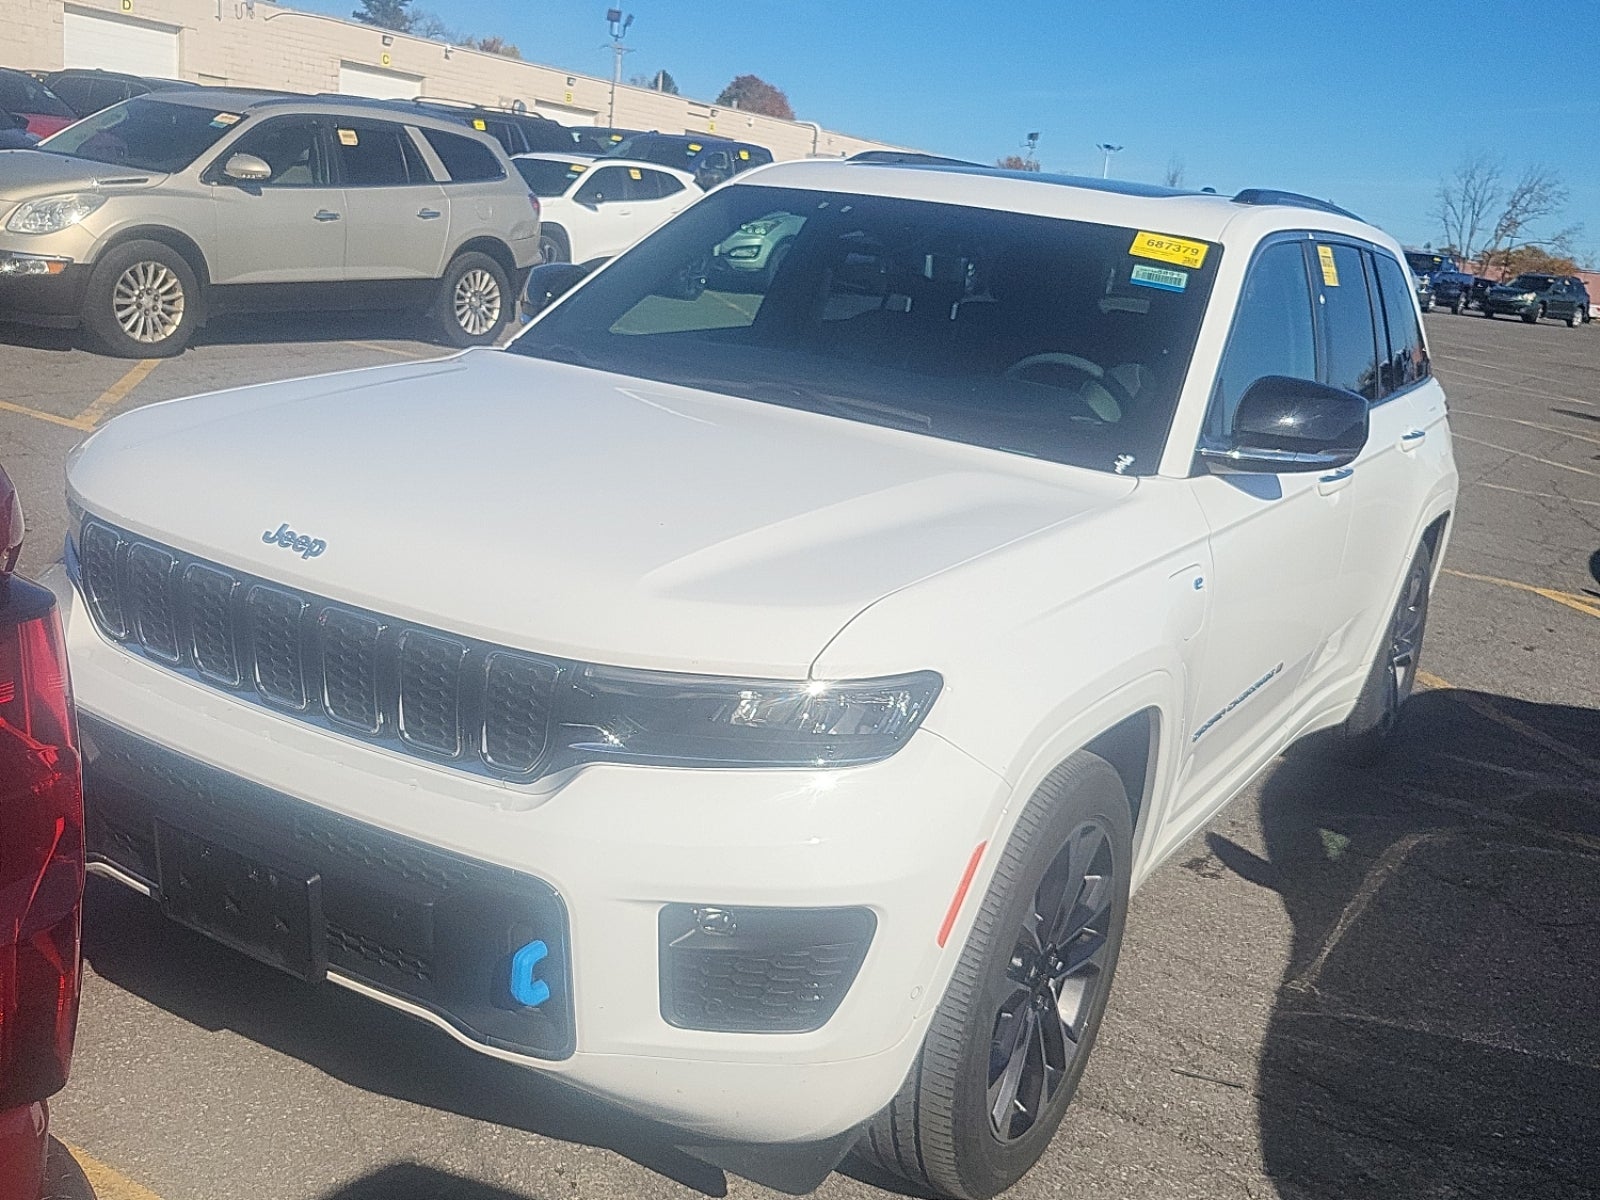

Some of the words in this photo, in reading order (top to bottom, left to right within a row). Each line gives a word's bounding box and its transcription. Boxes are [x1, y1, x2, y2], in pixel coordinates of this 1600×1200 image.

[122, 0, 131, 10] D
[382, 54, 390, 65] C
[1146, 238, 1200, 256] 687379
[262, 523, 327, 560] Jeep
[1193, 576, 1203, 590] e
